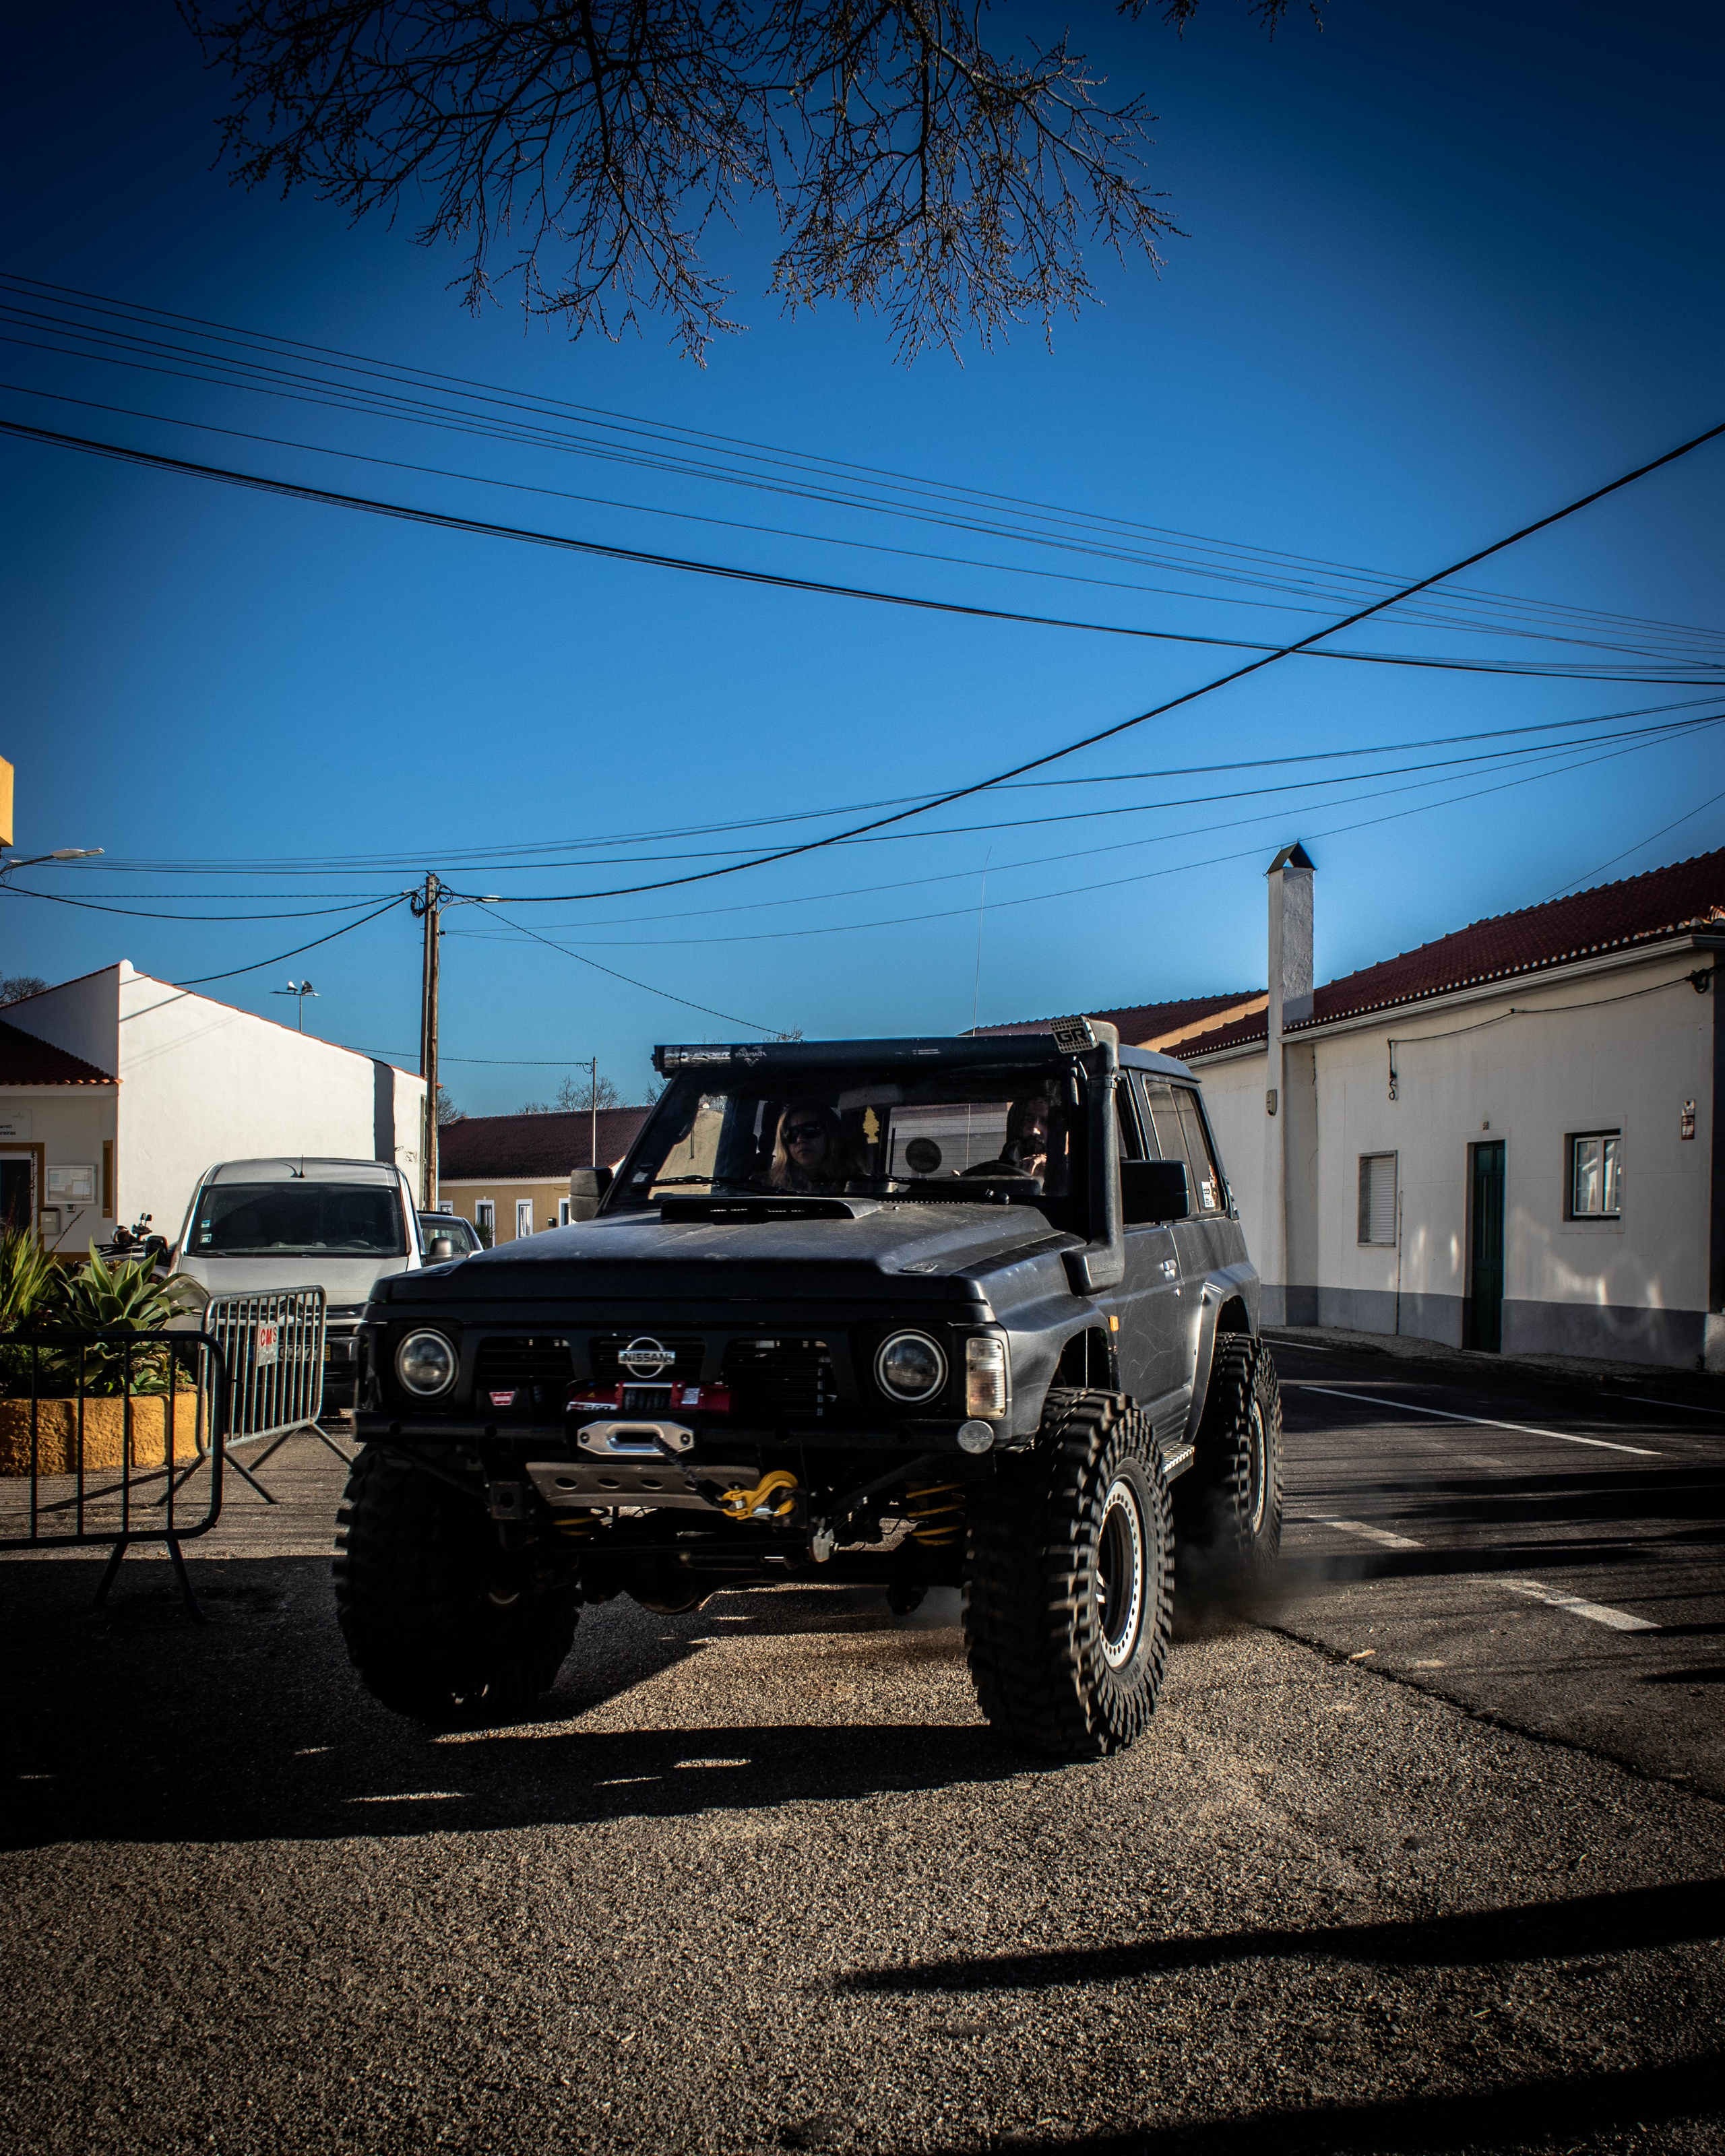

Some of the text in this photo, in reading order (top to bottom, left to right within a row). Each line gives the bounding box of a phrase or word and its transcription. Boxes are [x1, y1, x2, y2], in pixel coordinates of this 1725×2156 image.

[1055, 1027, 1088, 1044] GR
[260, 1326, 277, 1347] CMS
[623, 1352, 672, 1362] NISSAN
